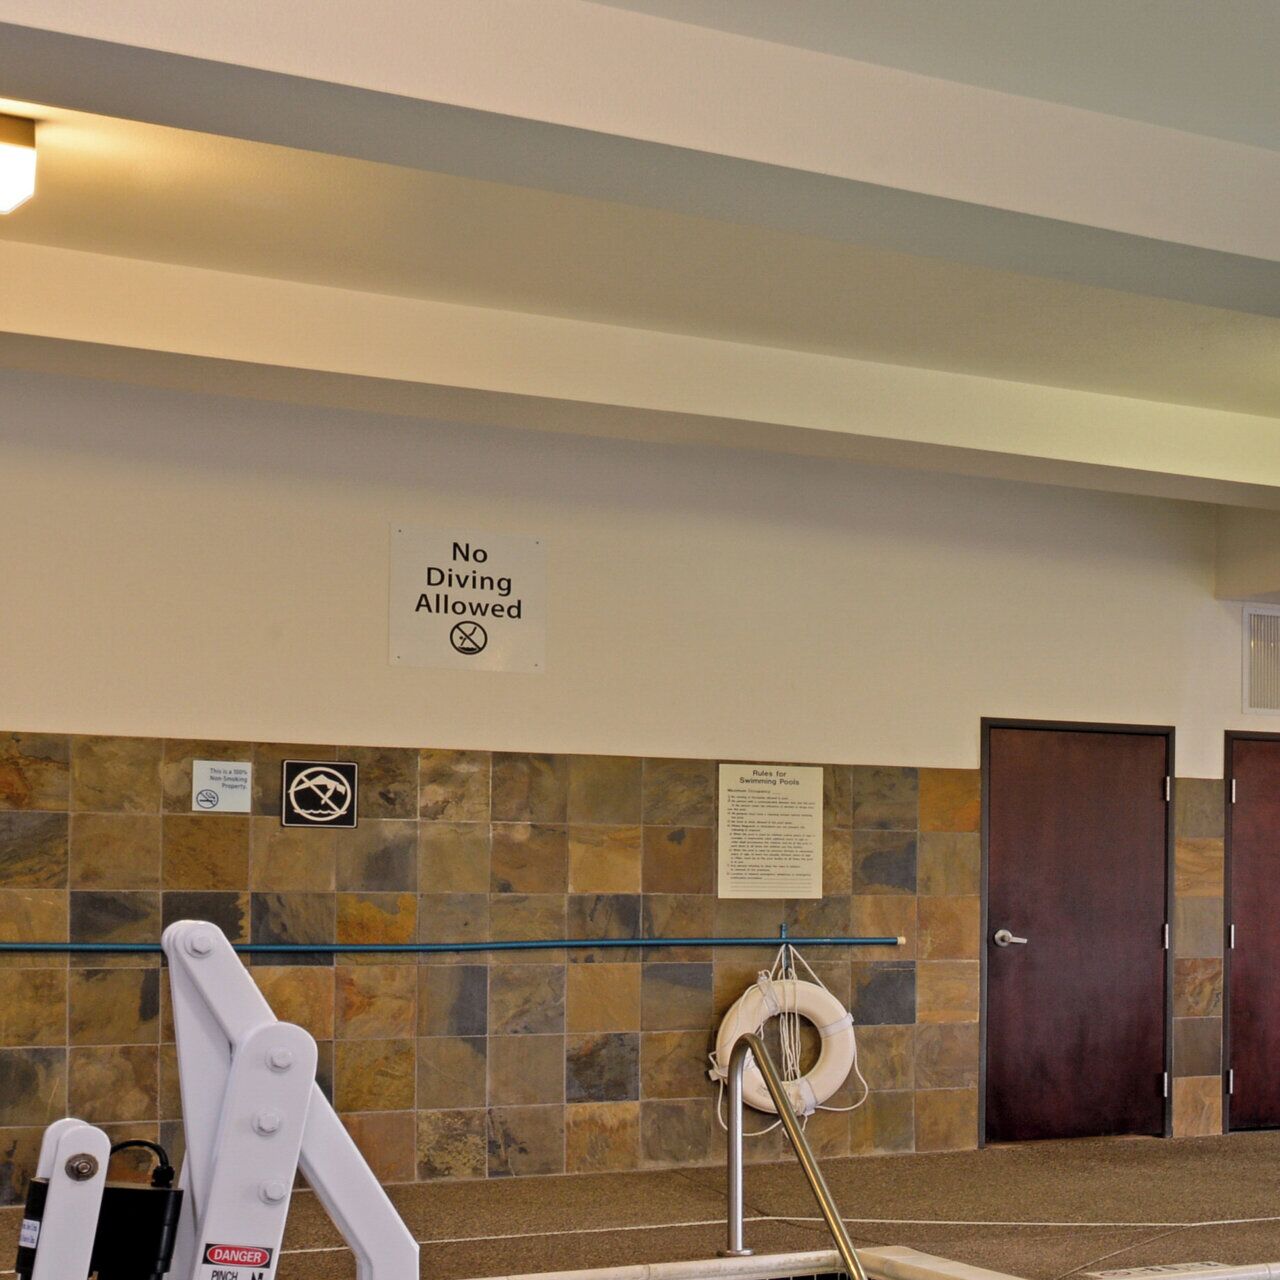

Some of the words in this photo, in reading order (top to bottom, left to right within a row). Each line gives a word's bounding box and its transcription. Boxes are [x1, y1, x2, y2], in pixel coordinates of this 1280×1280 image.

[452, 541, 488, 563] No
[427, 567, 511, 597] Diving
[415, 593, 522, 619] Allowed
[739, 777, 777, 785] Swimming
[779, 778, 800, 786] Pools
[752, 769, 773, 777] Rules
[213, 1248, 262, 1263] DANGER
